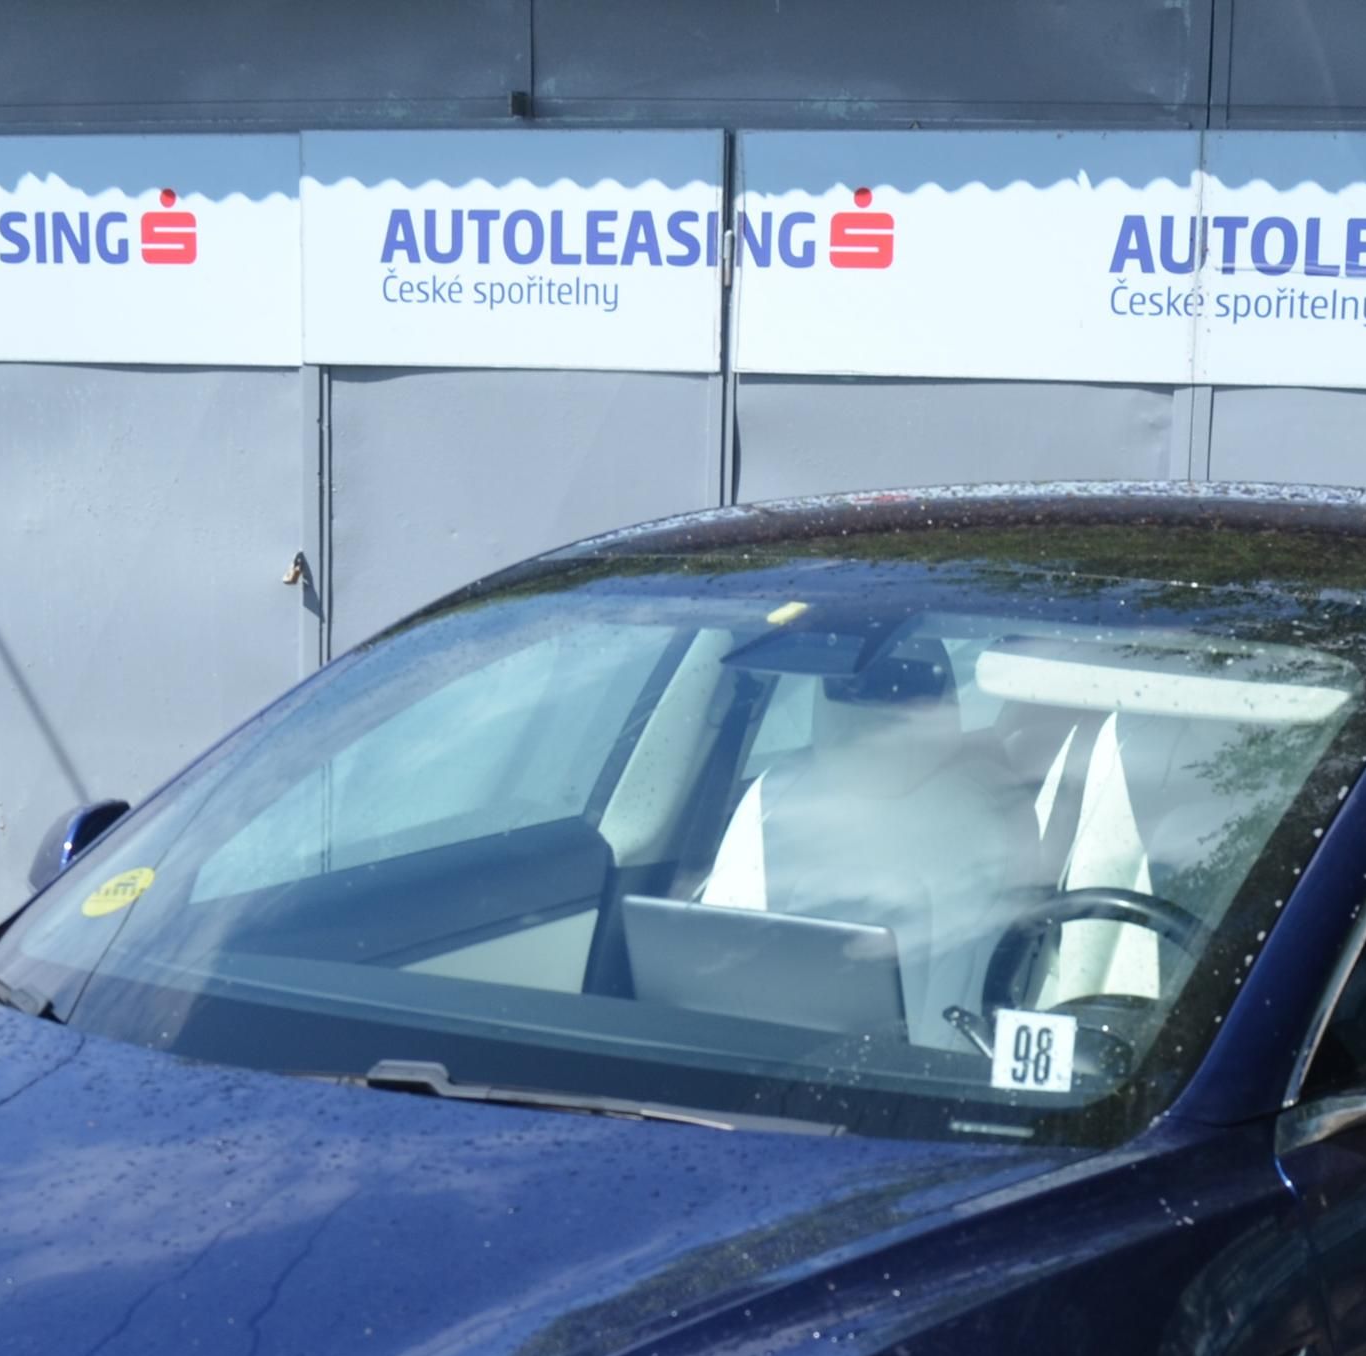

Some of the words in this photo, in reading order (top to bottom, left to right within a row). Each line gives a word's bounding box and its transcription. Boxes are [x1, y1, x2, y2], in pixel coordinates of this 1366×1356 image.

[380, 209, 816, 268] AUTOLEASING
[382, 268, 463, 305] České
[473, 275, 619, 312] spořitelny
[1110, 278, 1204, 317] České
[1011, 1025, 1053, 1085] 98
